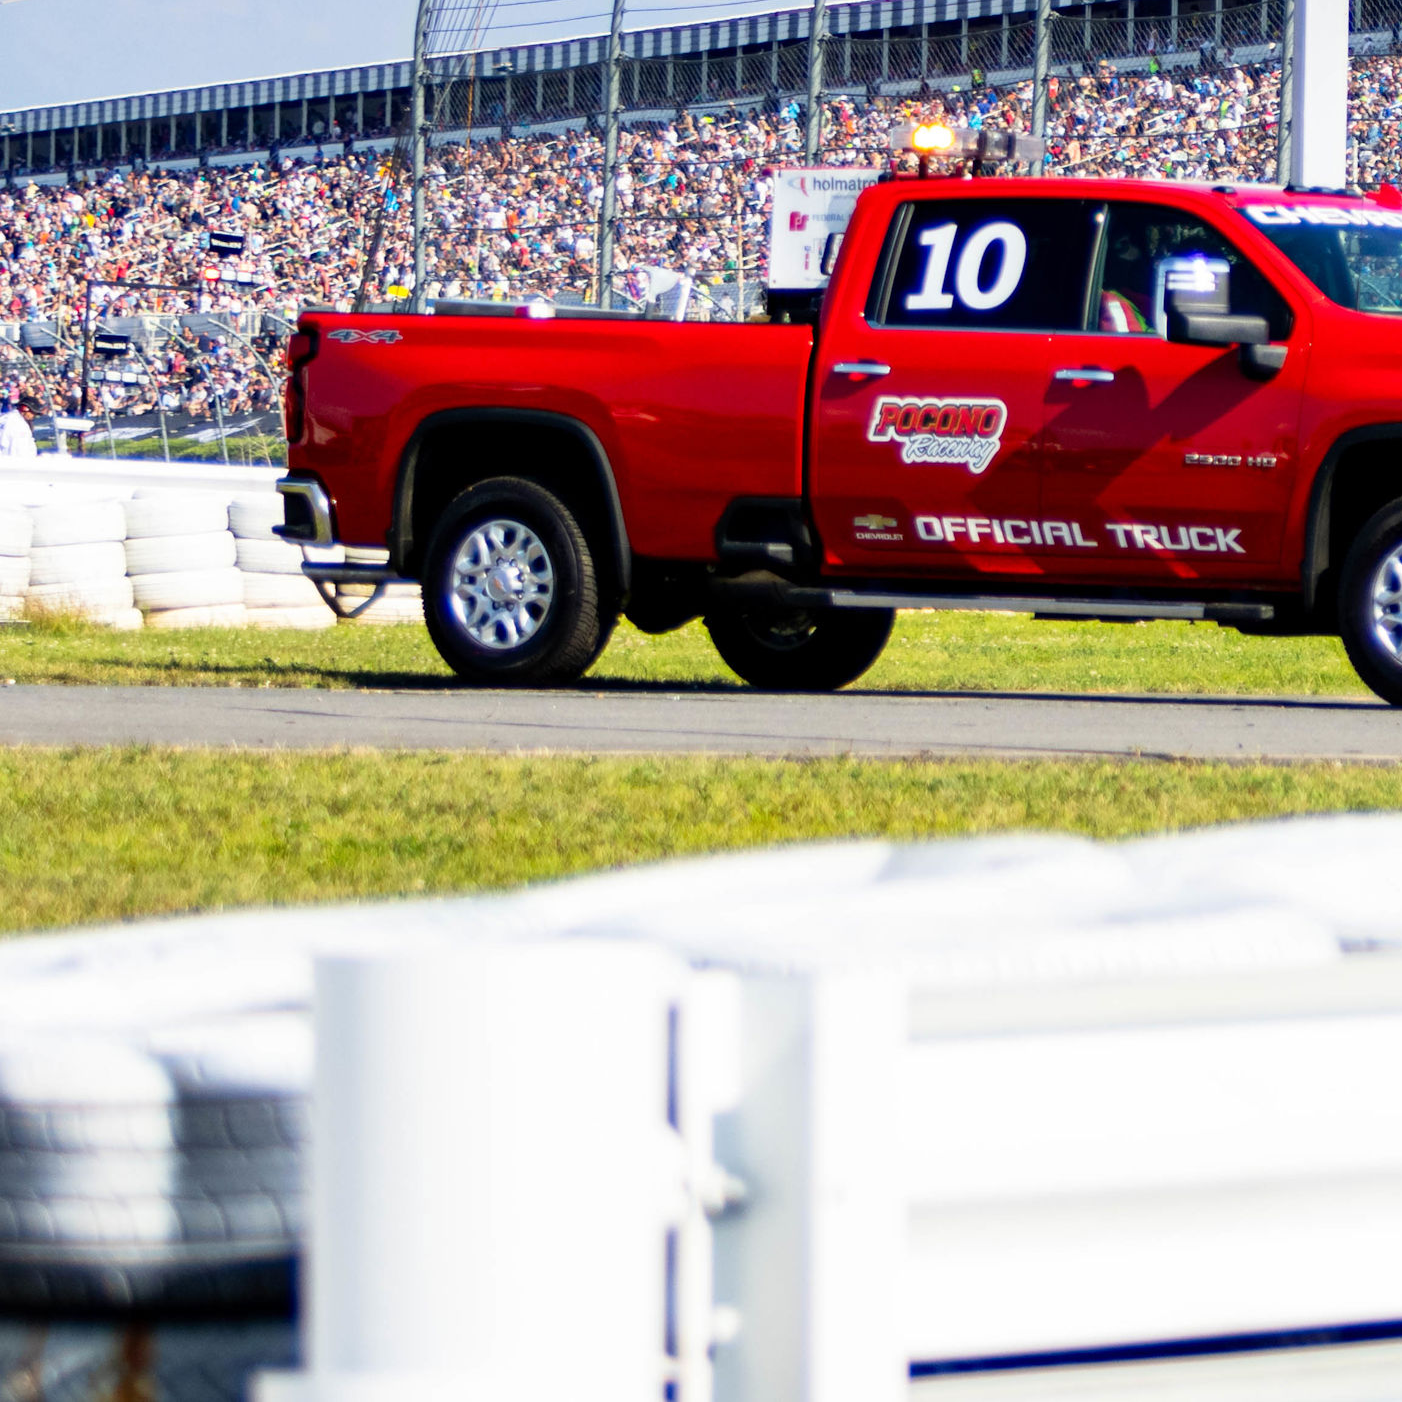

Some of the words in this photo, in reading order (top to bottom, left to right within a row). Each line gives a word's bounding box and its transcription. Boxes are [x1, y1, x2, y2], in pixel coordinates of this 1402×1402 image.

[905, 221, 1028, 311] 10
[873, 402, 1003, 438] POCONO
[905, 434, 998, 469] Raceway
[855, 531, 904, 541] CHEVROLET
[914, 515, 1099, 548] OFFICIAL
[1105, 522, 1246, 554] TRUCK
